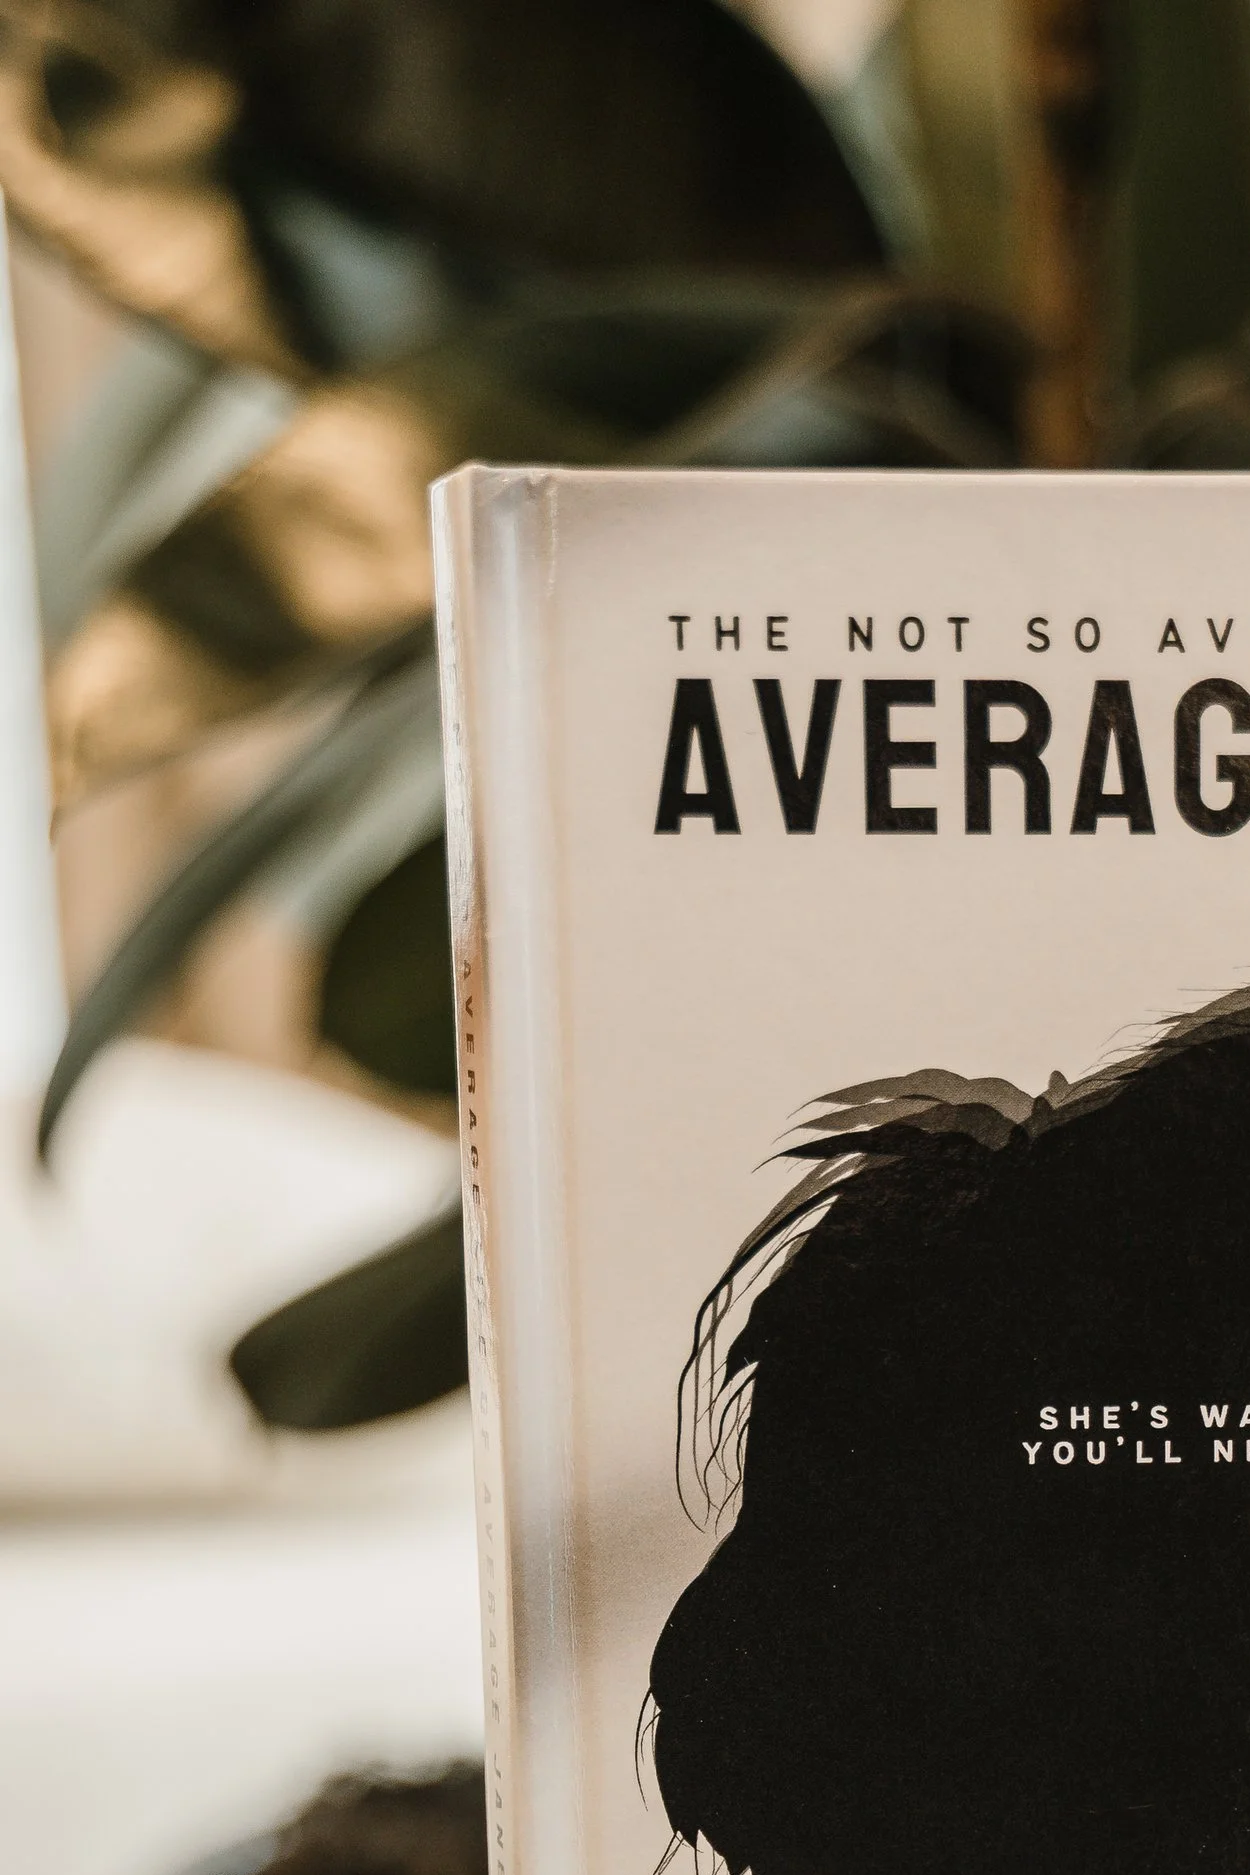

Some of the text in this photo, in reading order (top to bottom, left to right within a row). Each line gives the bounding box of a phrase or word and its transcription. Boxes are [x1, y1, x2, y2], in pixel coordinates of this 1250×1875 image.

[666, 614, 790, 652] THE
[847, 615, 971, 653] NOT
[1026, 616, 1101, 654] SO
[461, 959, 481, 1205] AVERAGE
[482, 1481, 501, 1725] AVERAGE
[1039, 1401, 1169, 1430] SHE'S
[1021, 1436, 1182, 1465] YOU'LL
